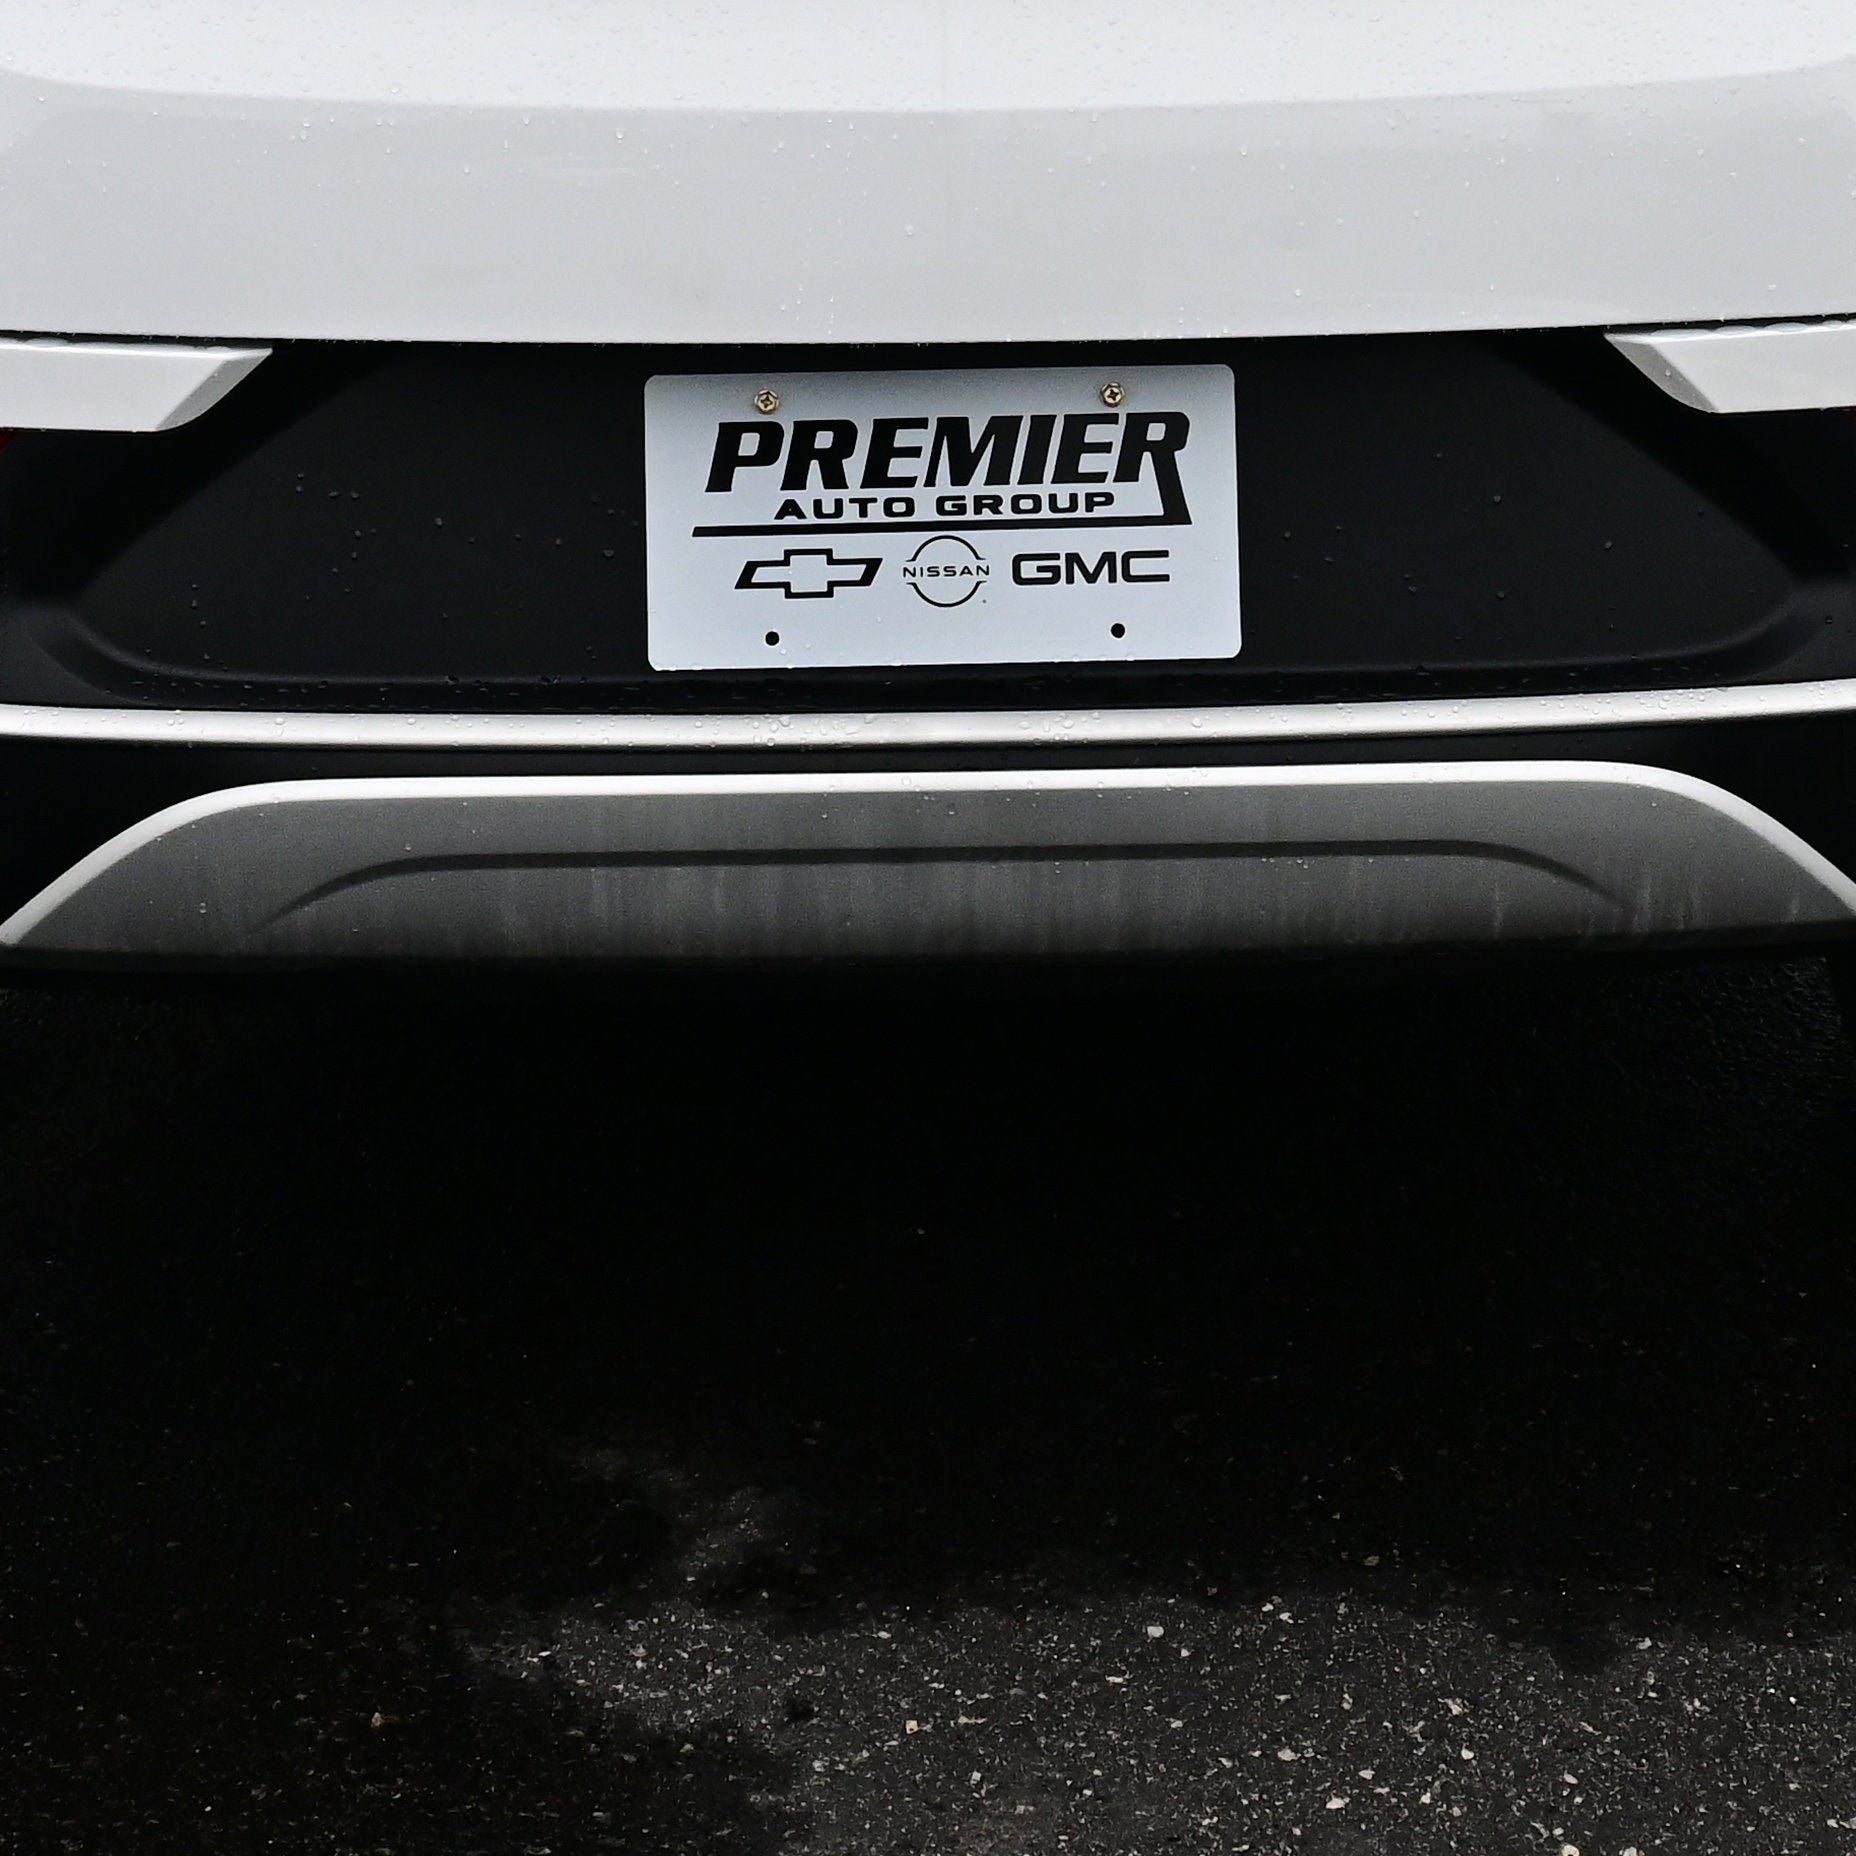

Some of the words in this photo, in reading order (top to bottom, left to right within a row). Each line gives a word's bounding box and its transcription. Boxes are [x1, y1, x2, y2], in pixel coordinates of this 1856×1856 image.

[704, 411, 1192, 526] PREMIER
[773, 496, 916, 521] AUTO
[935, 491, 1115, 517] GROUP
[902, 565, 990, 578] NISSAN
[1011, 549, 1171, 586] GMC
